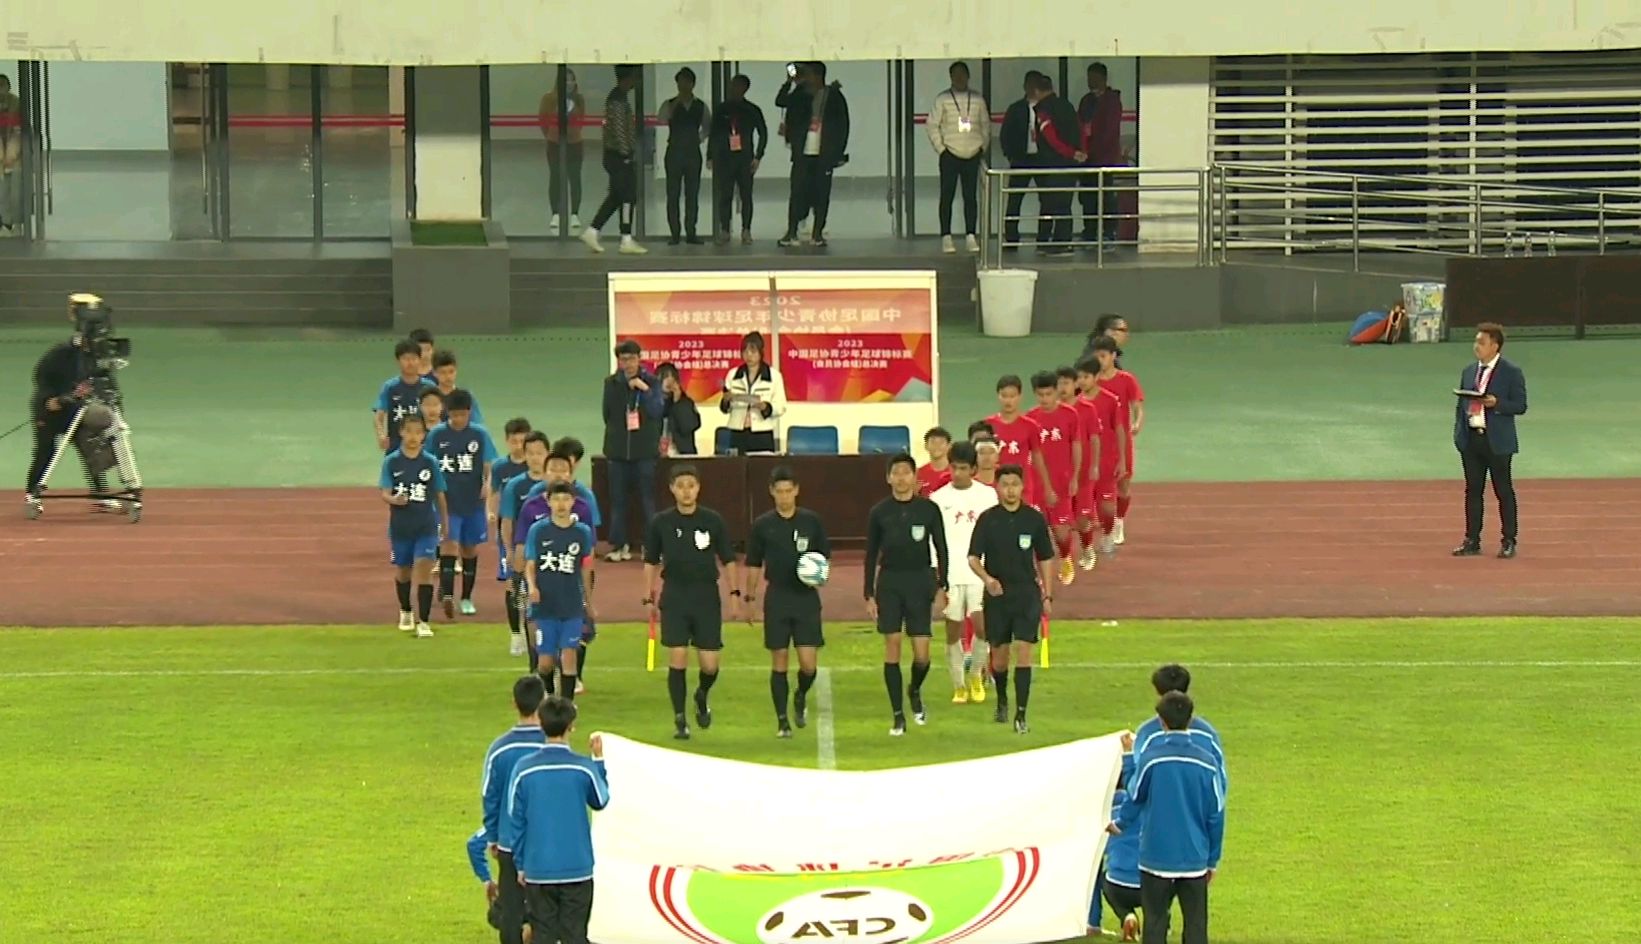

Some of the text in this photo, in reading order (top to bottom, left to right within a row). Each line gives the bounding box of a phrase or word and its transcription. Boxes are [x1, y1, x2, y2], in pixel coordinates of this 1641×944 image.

[678, 340, 704, 349] 2023
[837, 339, 864, 348] 2023
[439, 453, 474, 473] 大连
[539, 551, 576, 574] 大连
